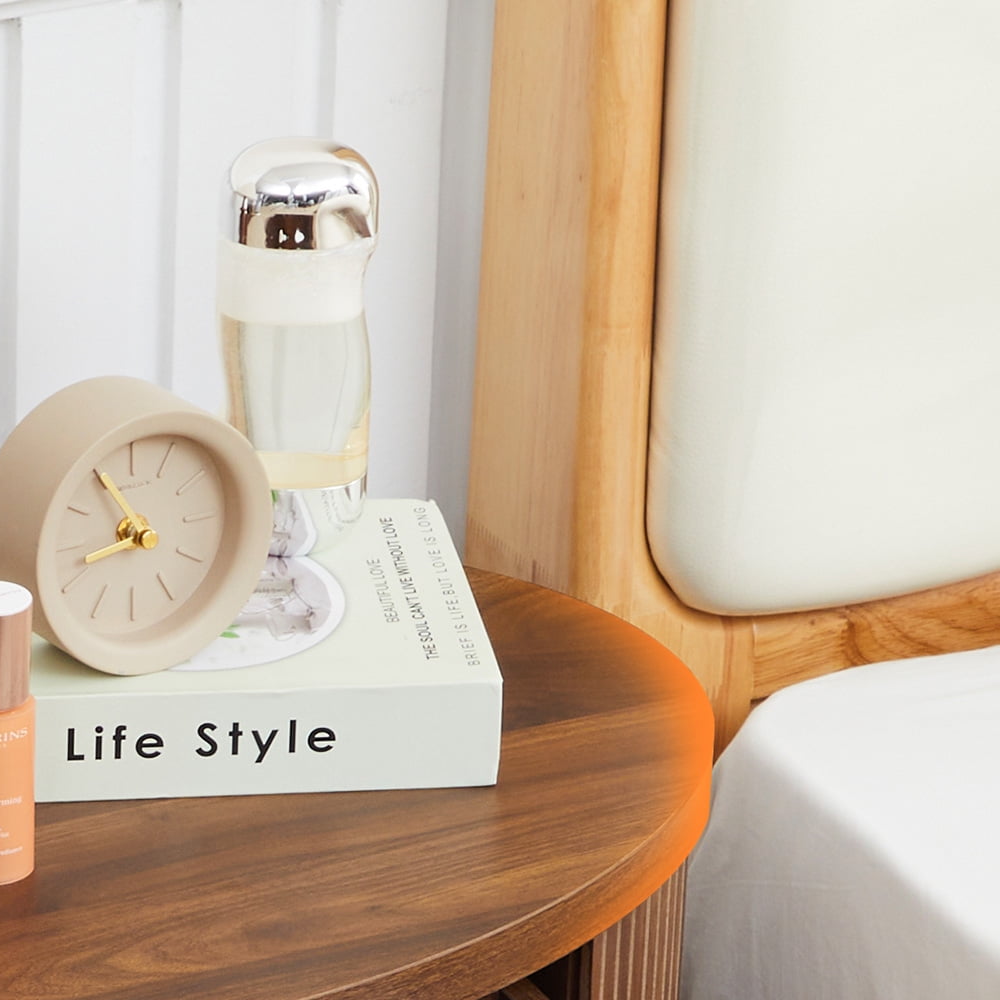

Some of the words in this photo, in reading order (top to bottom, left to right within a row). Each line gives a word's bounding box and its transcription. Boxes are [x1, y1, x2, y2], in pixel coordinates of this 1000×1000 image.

[379, 517, 397, 539] LOVE
[413, 506, 433, 533] LONG
[423, 536, 437, 546] IS
[366, 558, 385, 579] LOVE
[387, 540, 410, 576] WITHOUT
[427, 549, 447, 574] LOVE
[400, 576, 416, 594] LIVE
[374, 580, 399, 623] BEAUTIFUL
[415, 620, 433, 642] SOUL
[454, 623, 469, 633] IS
[422, 643, 439, 660] THE
[459, 637, 480, 666] BRIEF
[66, 725, 164, 761] Life
[195, 719, 336, 763] Style
